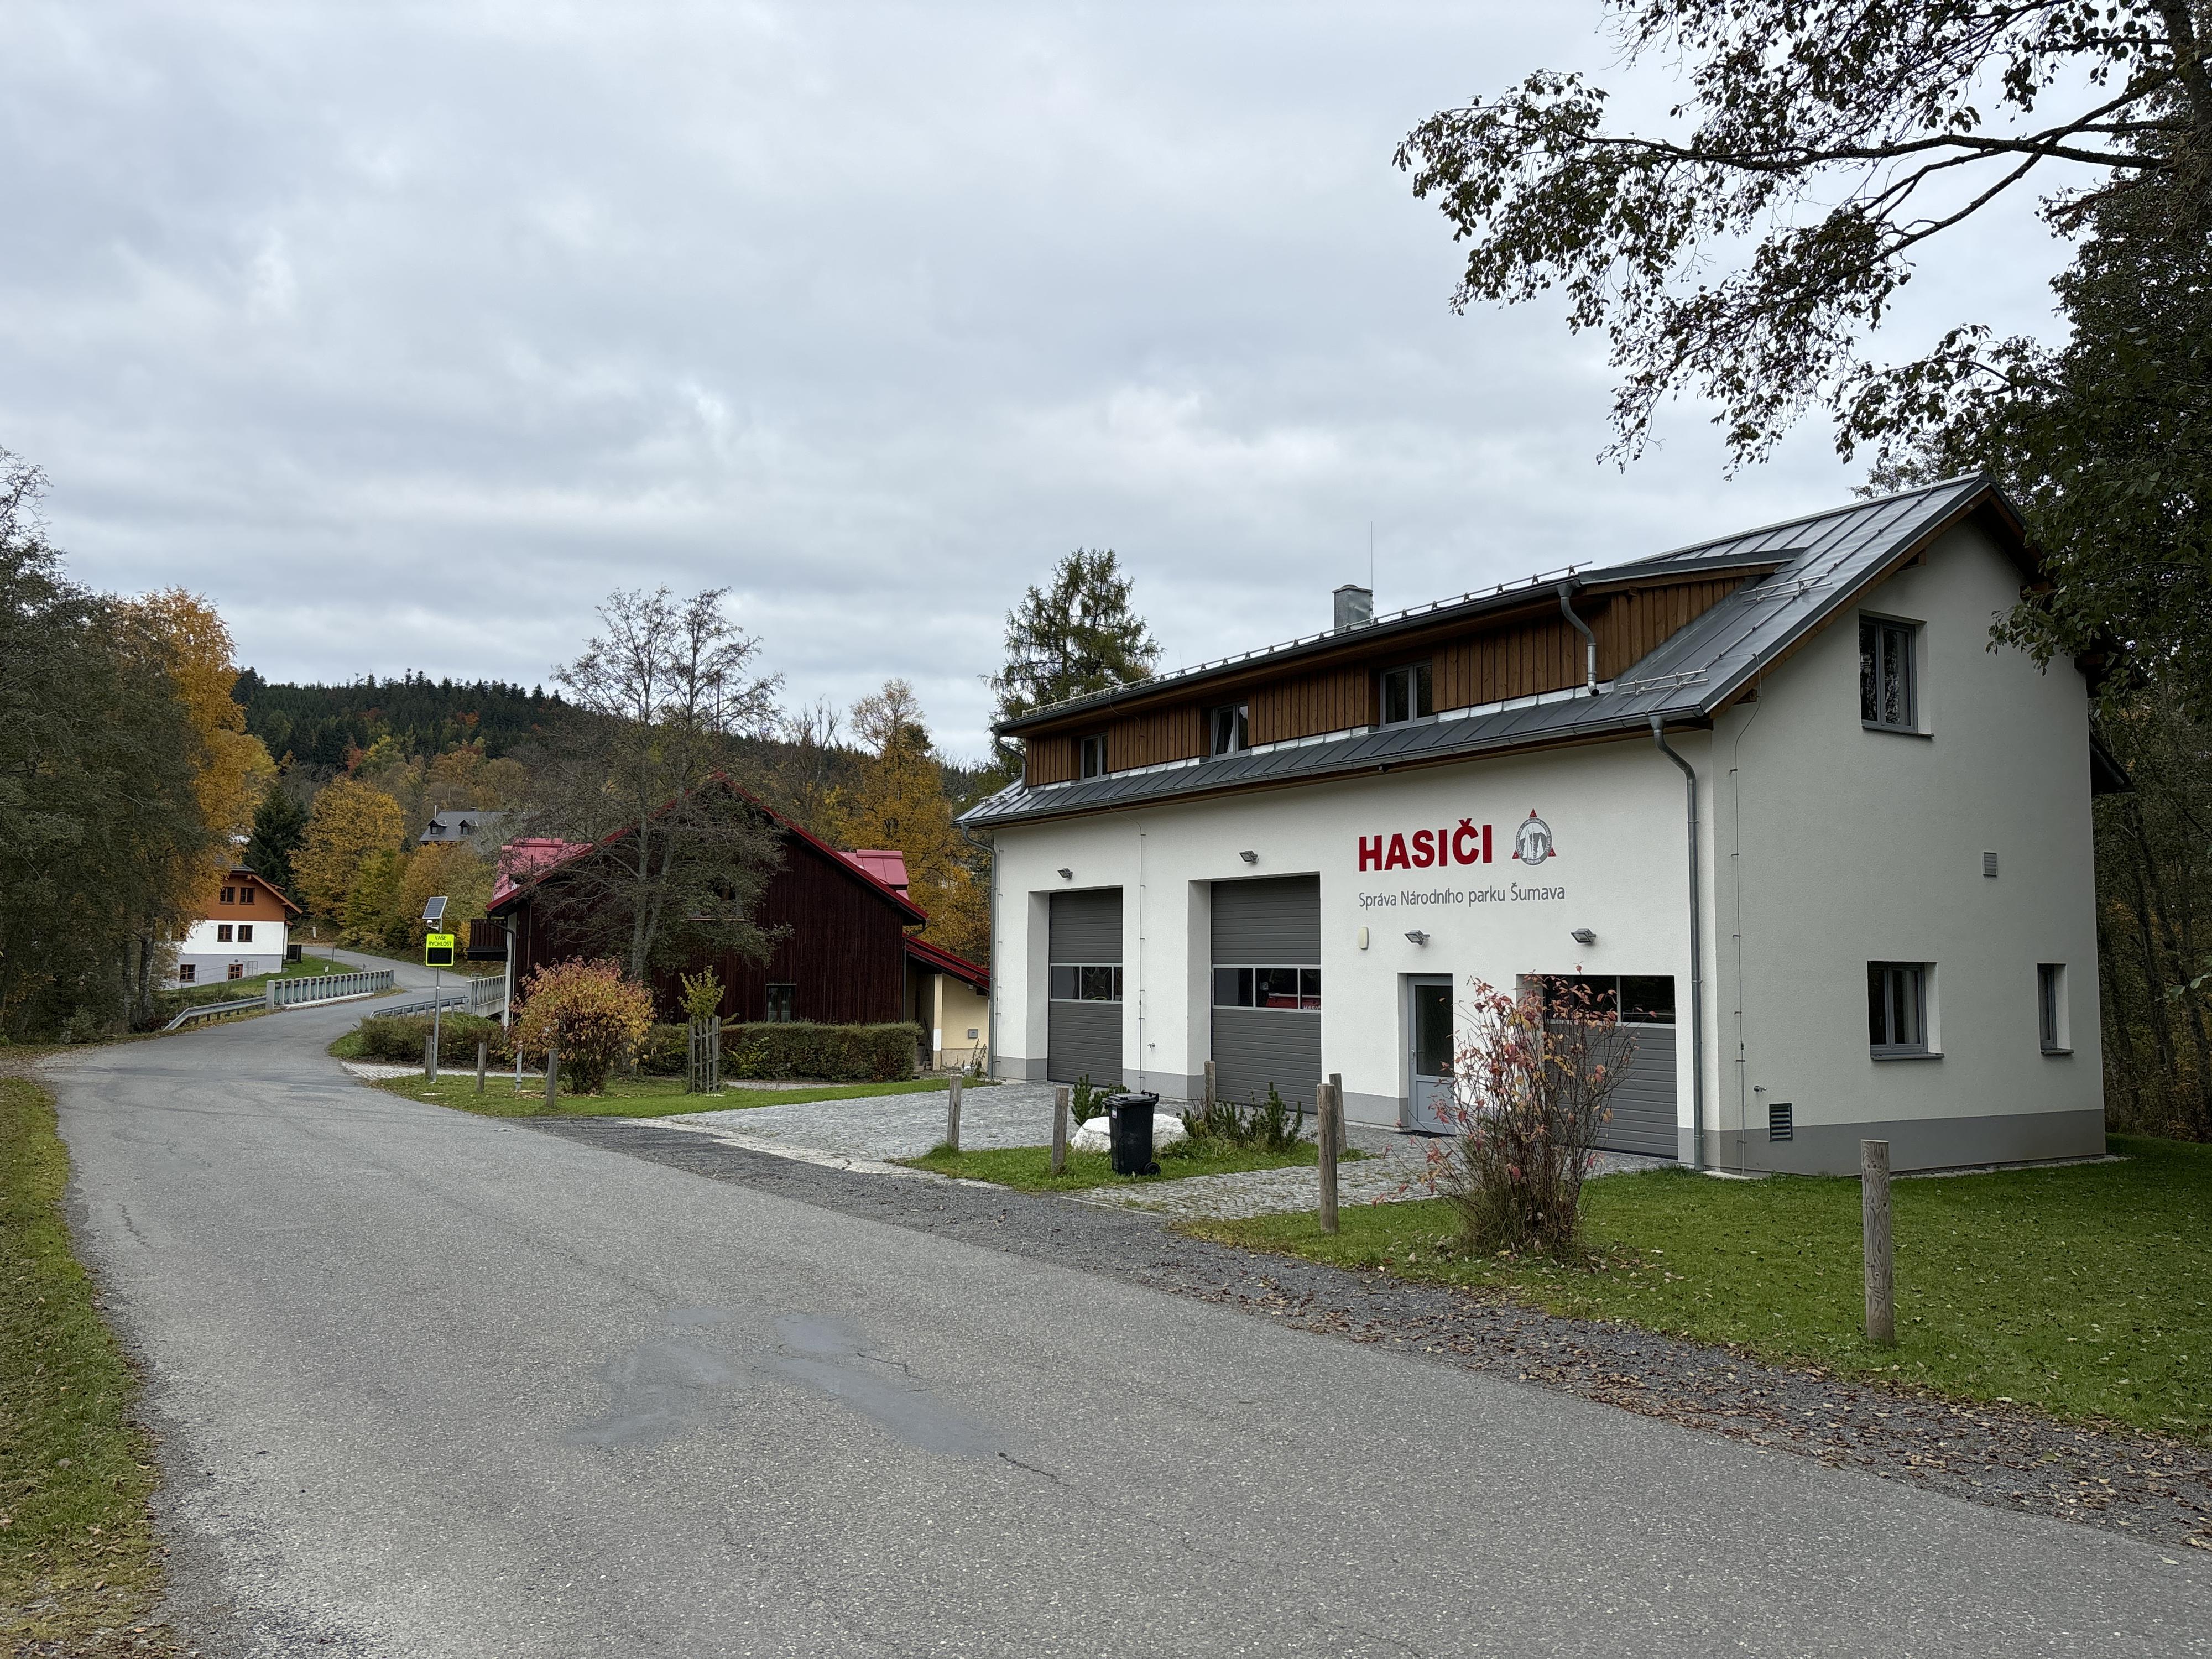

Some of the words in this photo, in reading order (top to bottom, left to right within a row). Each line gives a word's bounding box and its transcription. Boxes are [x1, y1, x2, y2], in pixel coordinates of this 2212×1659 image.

[1359, 817, 1493, 872] HASIČI
[1359, 892, 1397, 911] Správa
[1401, 887, 1464, 906] Národního
[1468, 885, 1505, 907] parku
[1510, 881, 1566, 901] Šumava
